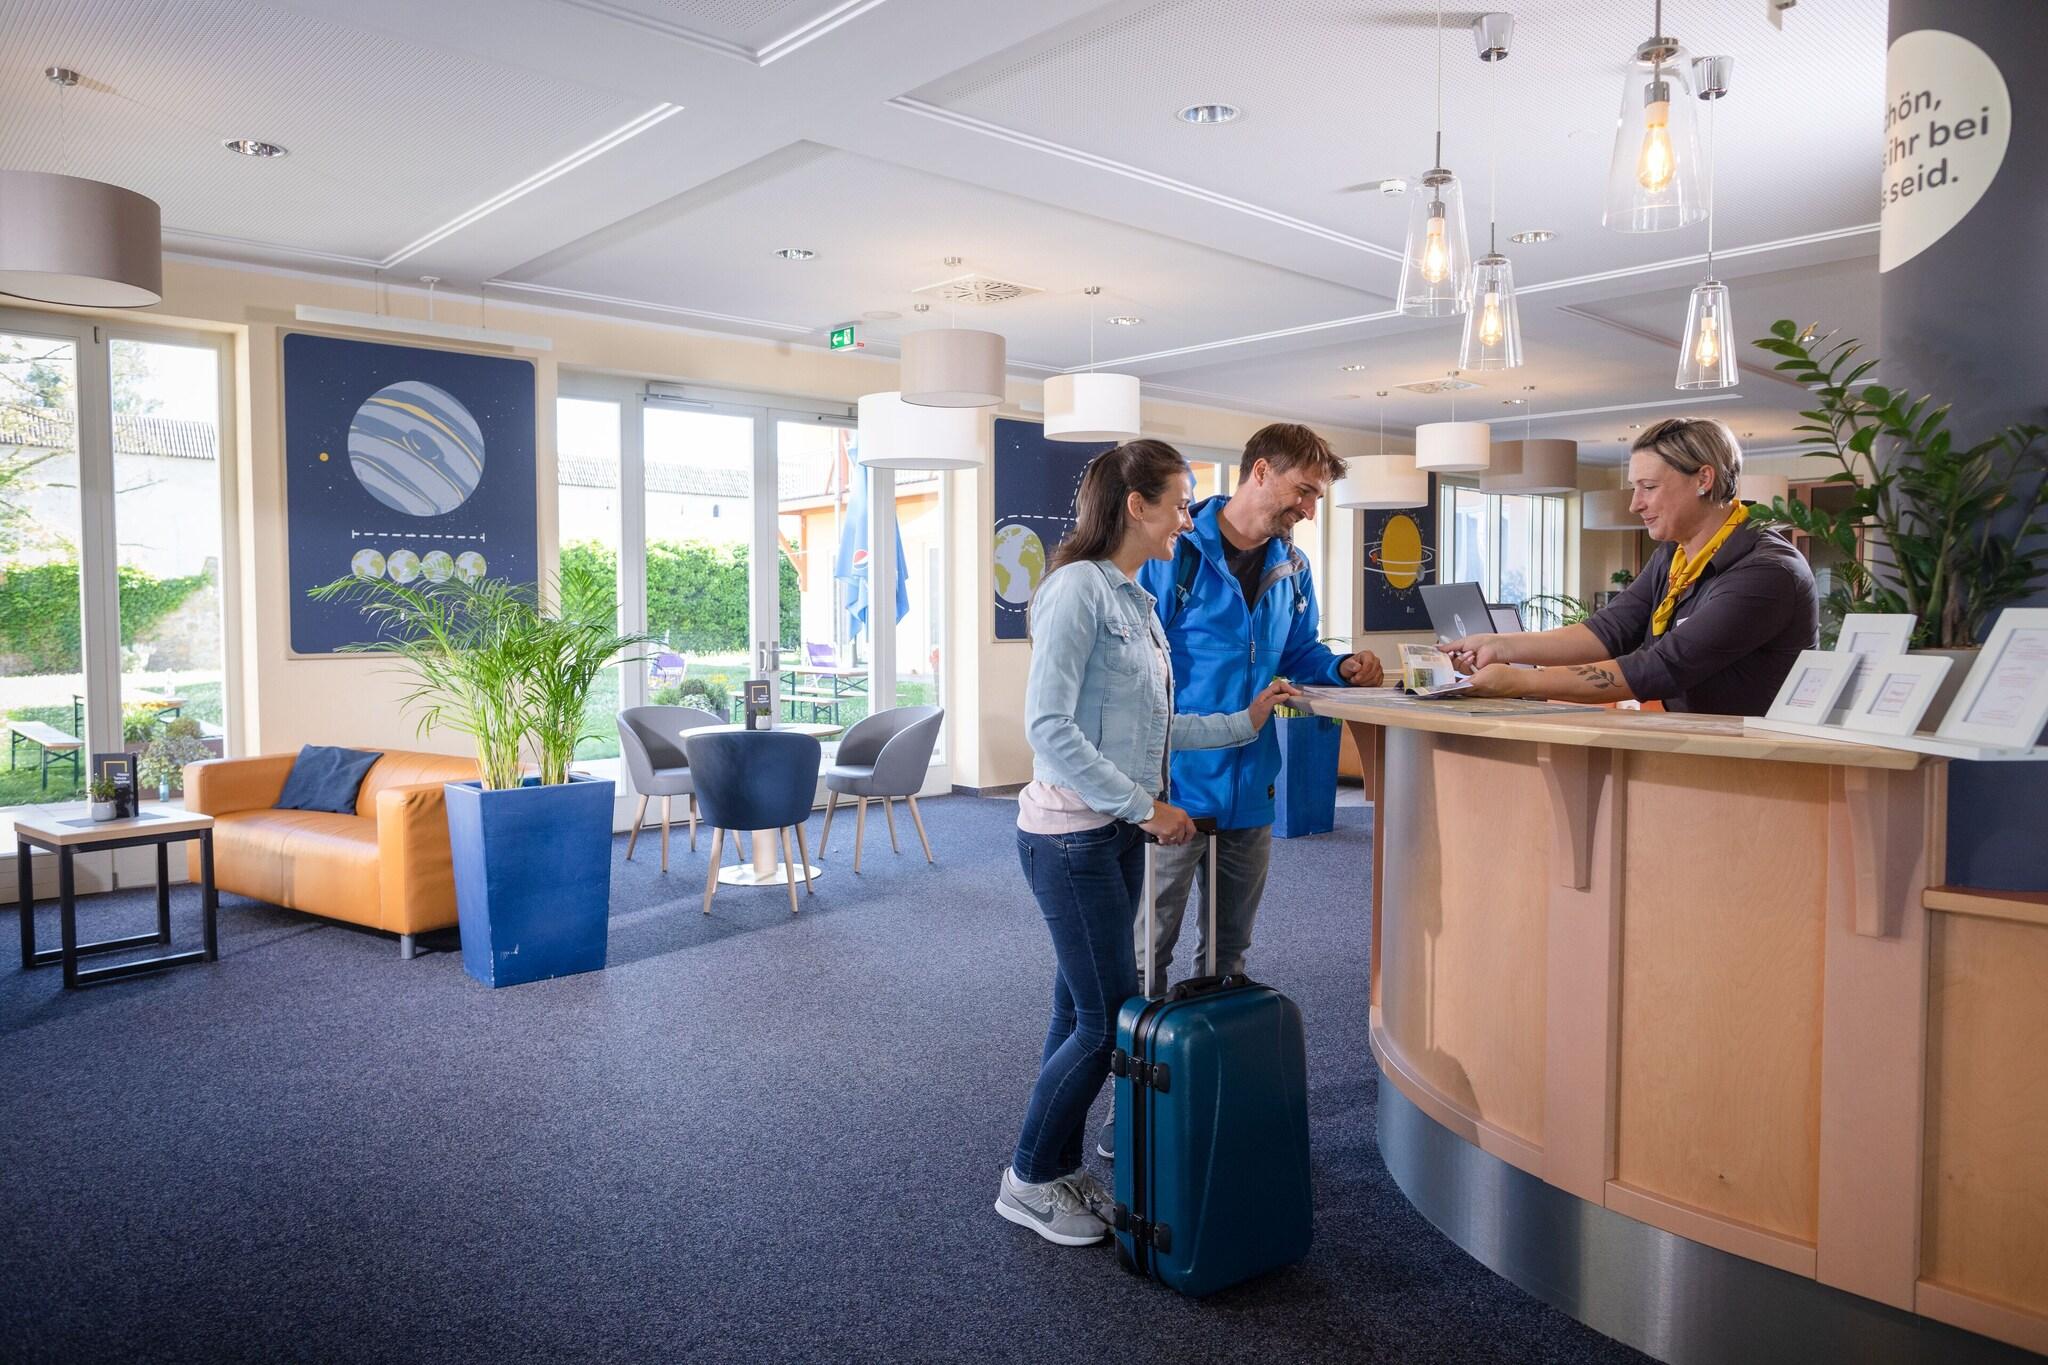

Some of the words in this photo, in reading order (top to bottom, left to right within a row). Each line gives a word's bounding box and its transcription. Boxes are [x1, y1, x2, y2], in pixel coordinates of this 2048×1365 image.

[1889, 134, 1920, 165] ihr
[1929, 106, 1989, 148] bei
[1890, 158, 1959, 203] seid.
